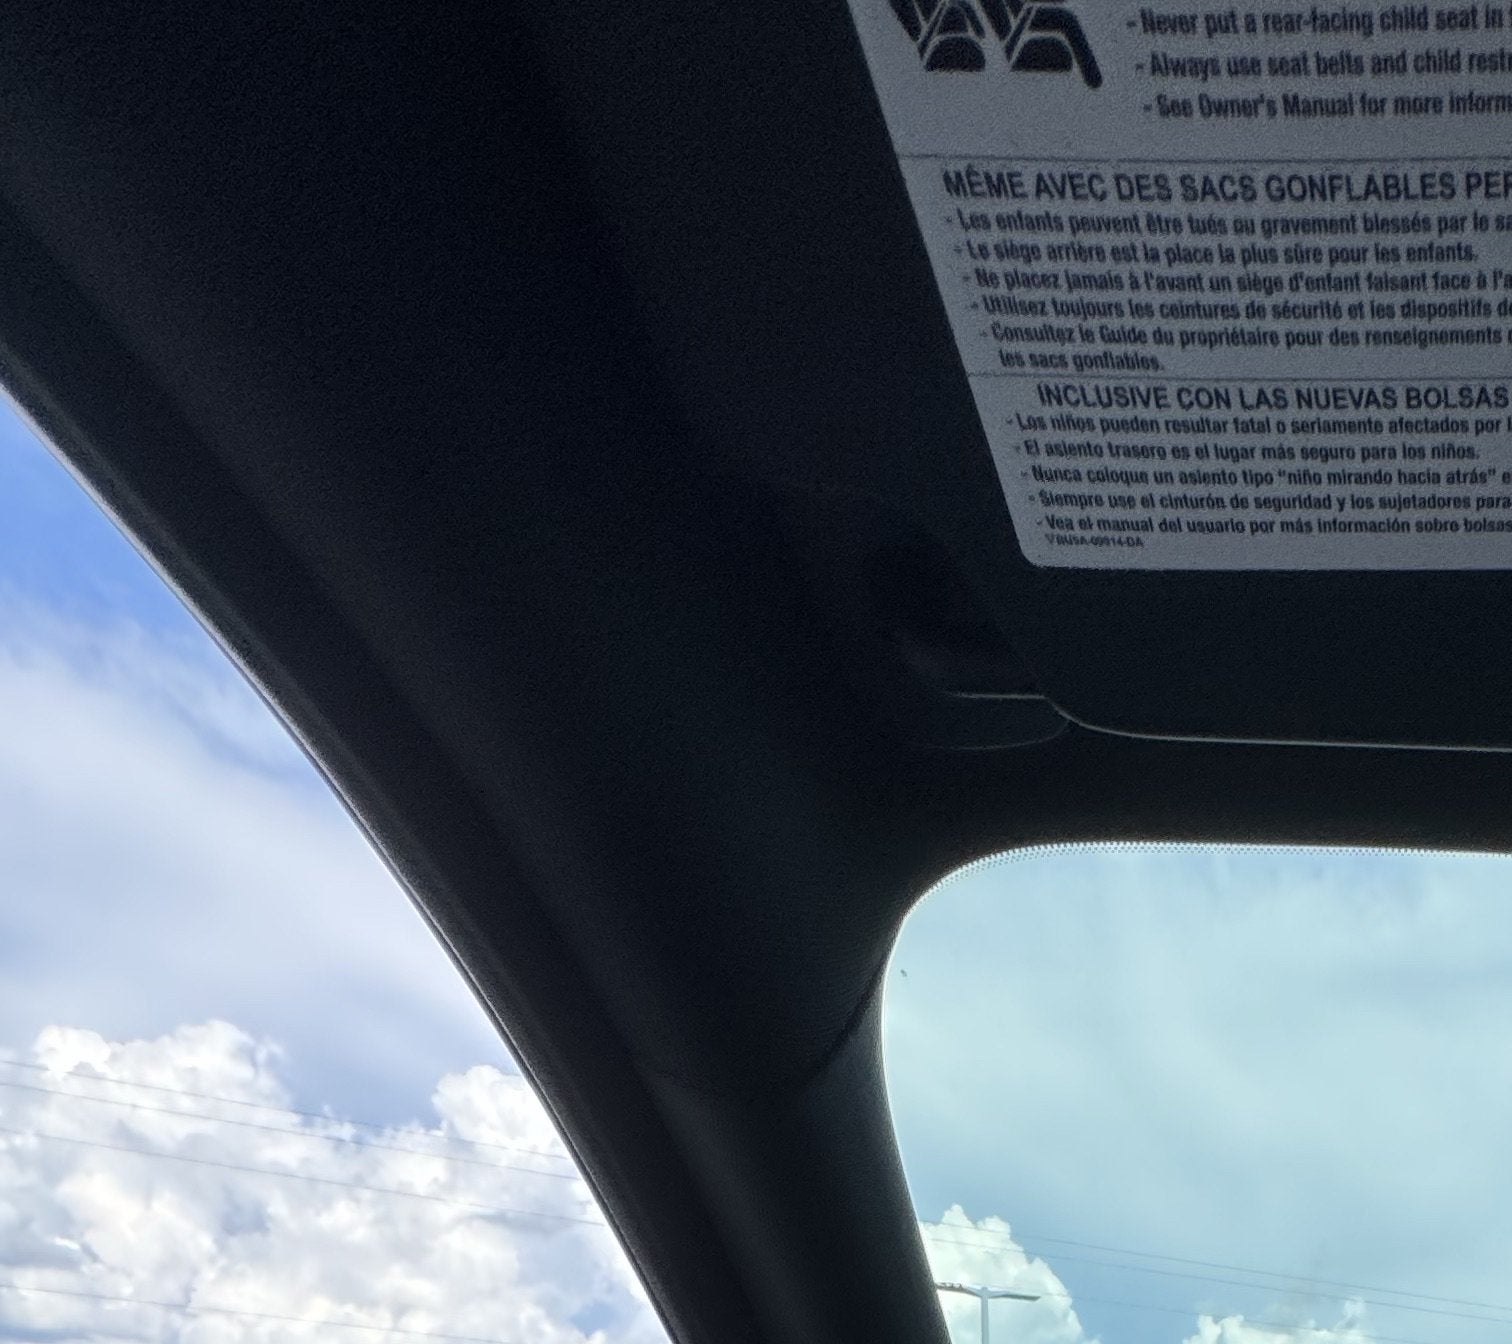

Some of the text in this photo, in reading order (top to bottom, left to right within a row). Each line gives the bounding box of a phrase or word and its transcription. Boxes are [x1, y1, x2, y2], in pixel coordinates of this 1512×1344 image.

[1140, 10, 1197, 36] Never
[1204, 11, 1238, 36] put
[1244, 12, 1257, 35] a
[1263, 10, 1374, 35] rear-facing
[1379, 5, 1429, 33] child
[1435, 7, 1478, 32] seat
[1484, 4, 1504, 32] in
[1150, 53, 1220, 79] Always
[1227, 56, 1262, 78] use
[1268, 54, 1309, 78] seat
[1315, 50, 1364, 78] belts
[1370, 52, 1408, 77] and
[1413, 47, 1462, 75] child
[1157, 94, 1193, 119] See
[1198, 93, 1277, 119] Owner's
[1282, 93, 1354, 119] Manual
[1359, 92, 1386, 117] for
[1393, 95, 1443, 117] more
[943, 169, 1023, 199] MÊME
[1035, 172, 1106, 200] AVEC
[1115, 173, 1172, 200] DES
[1180, 174, 1257, 200] SACS
[1265, 174, 1456, 200] GONFLABLES
[1037, 384, 1167, 409] INCLUSIVE
[1177, 386, 1231, 411] CON
[1239, 387, 1288, 411] LAS
[1295, 386, 1398, 411] NUEVAS
[1405, 384, 1509, 410] BOLSAS
